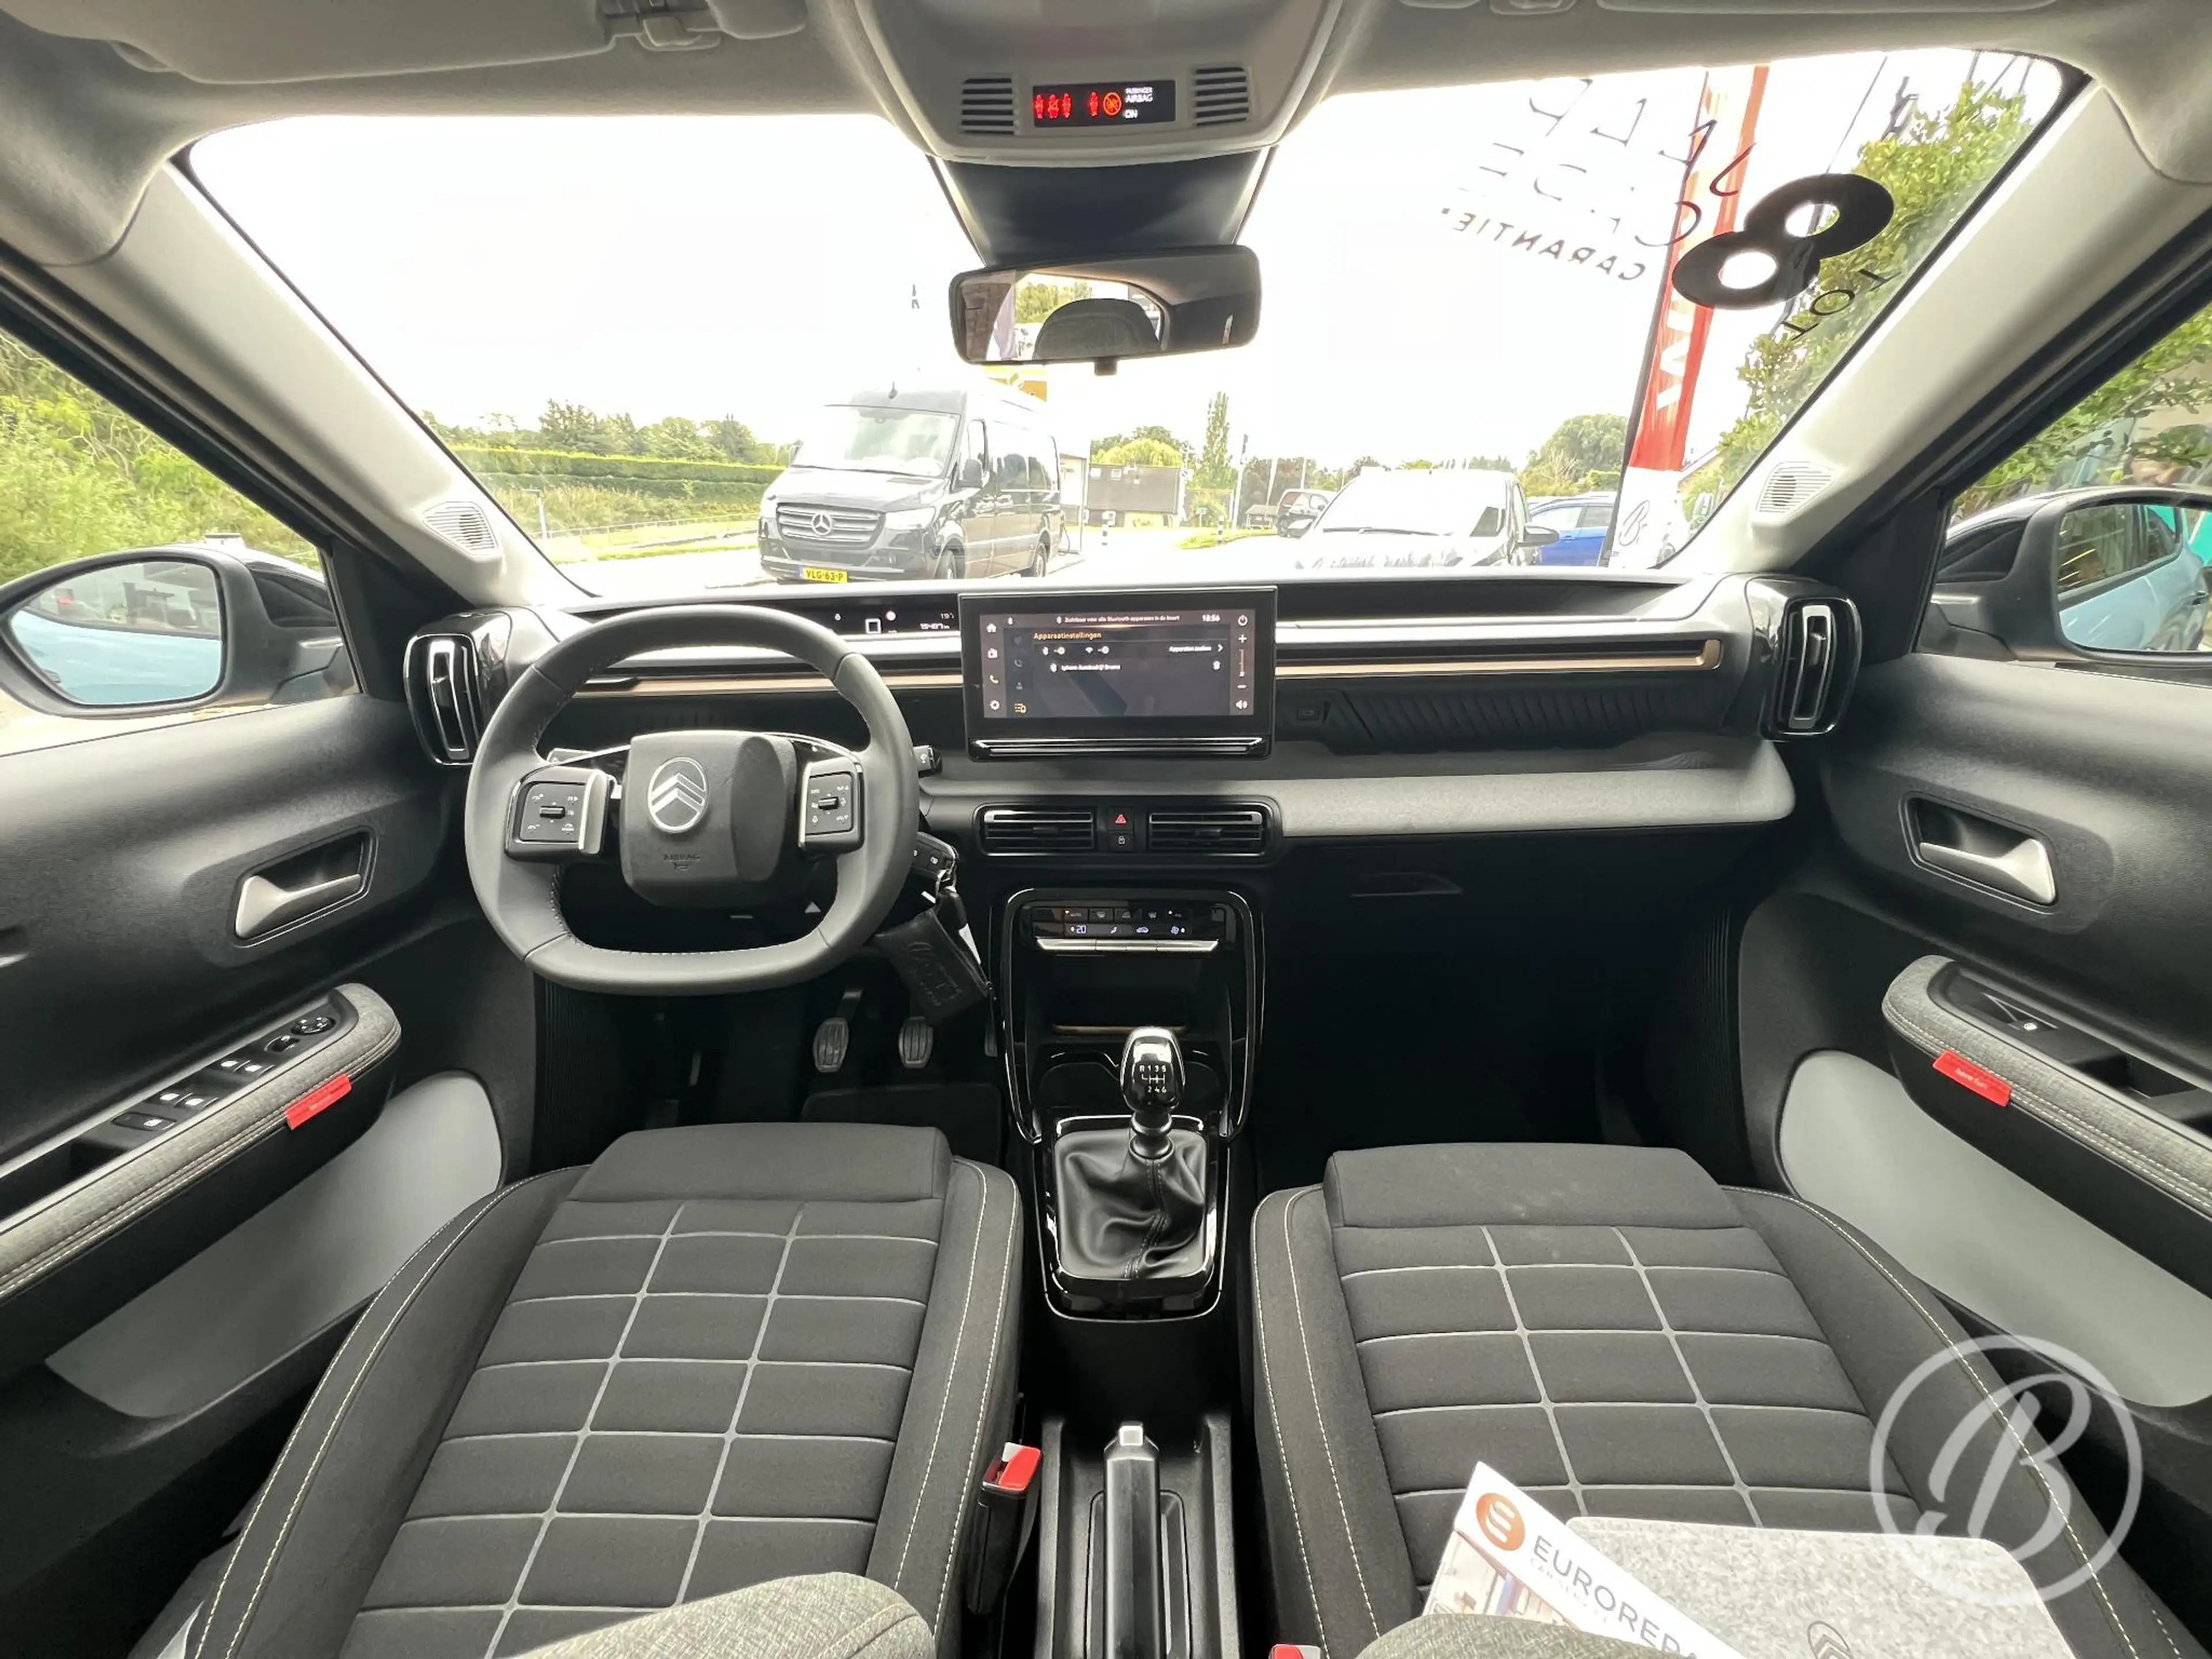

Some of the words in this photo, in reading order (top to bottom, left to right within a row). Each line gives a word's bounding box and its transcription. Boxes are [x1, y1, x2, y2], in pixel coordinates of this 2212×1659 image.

[1125, 94, 1153, 103] AIRBAG
[1125, 109, 1138, 119] ON
[1033, 632, 1101, 640] Apparaatinstellingen
[1076, 925, 1086, 934] 20
